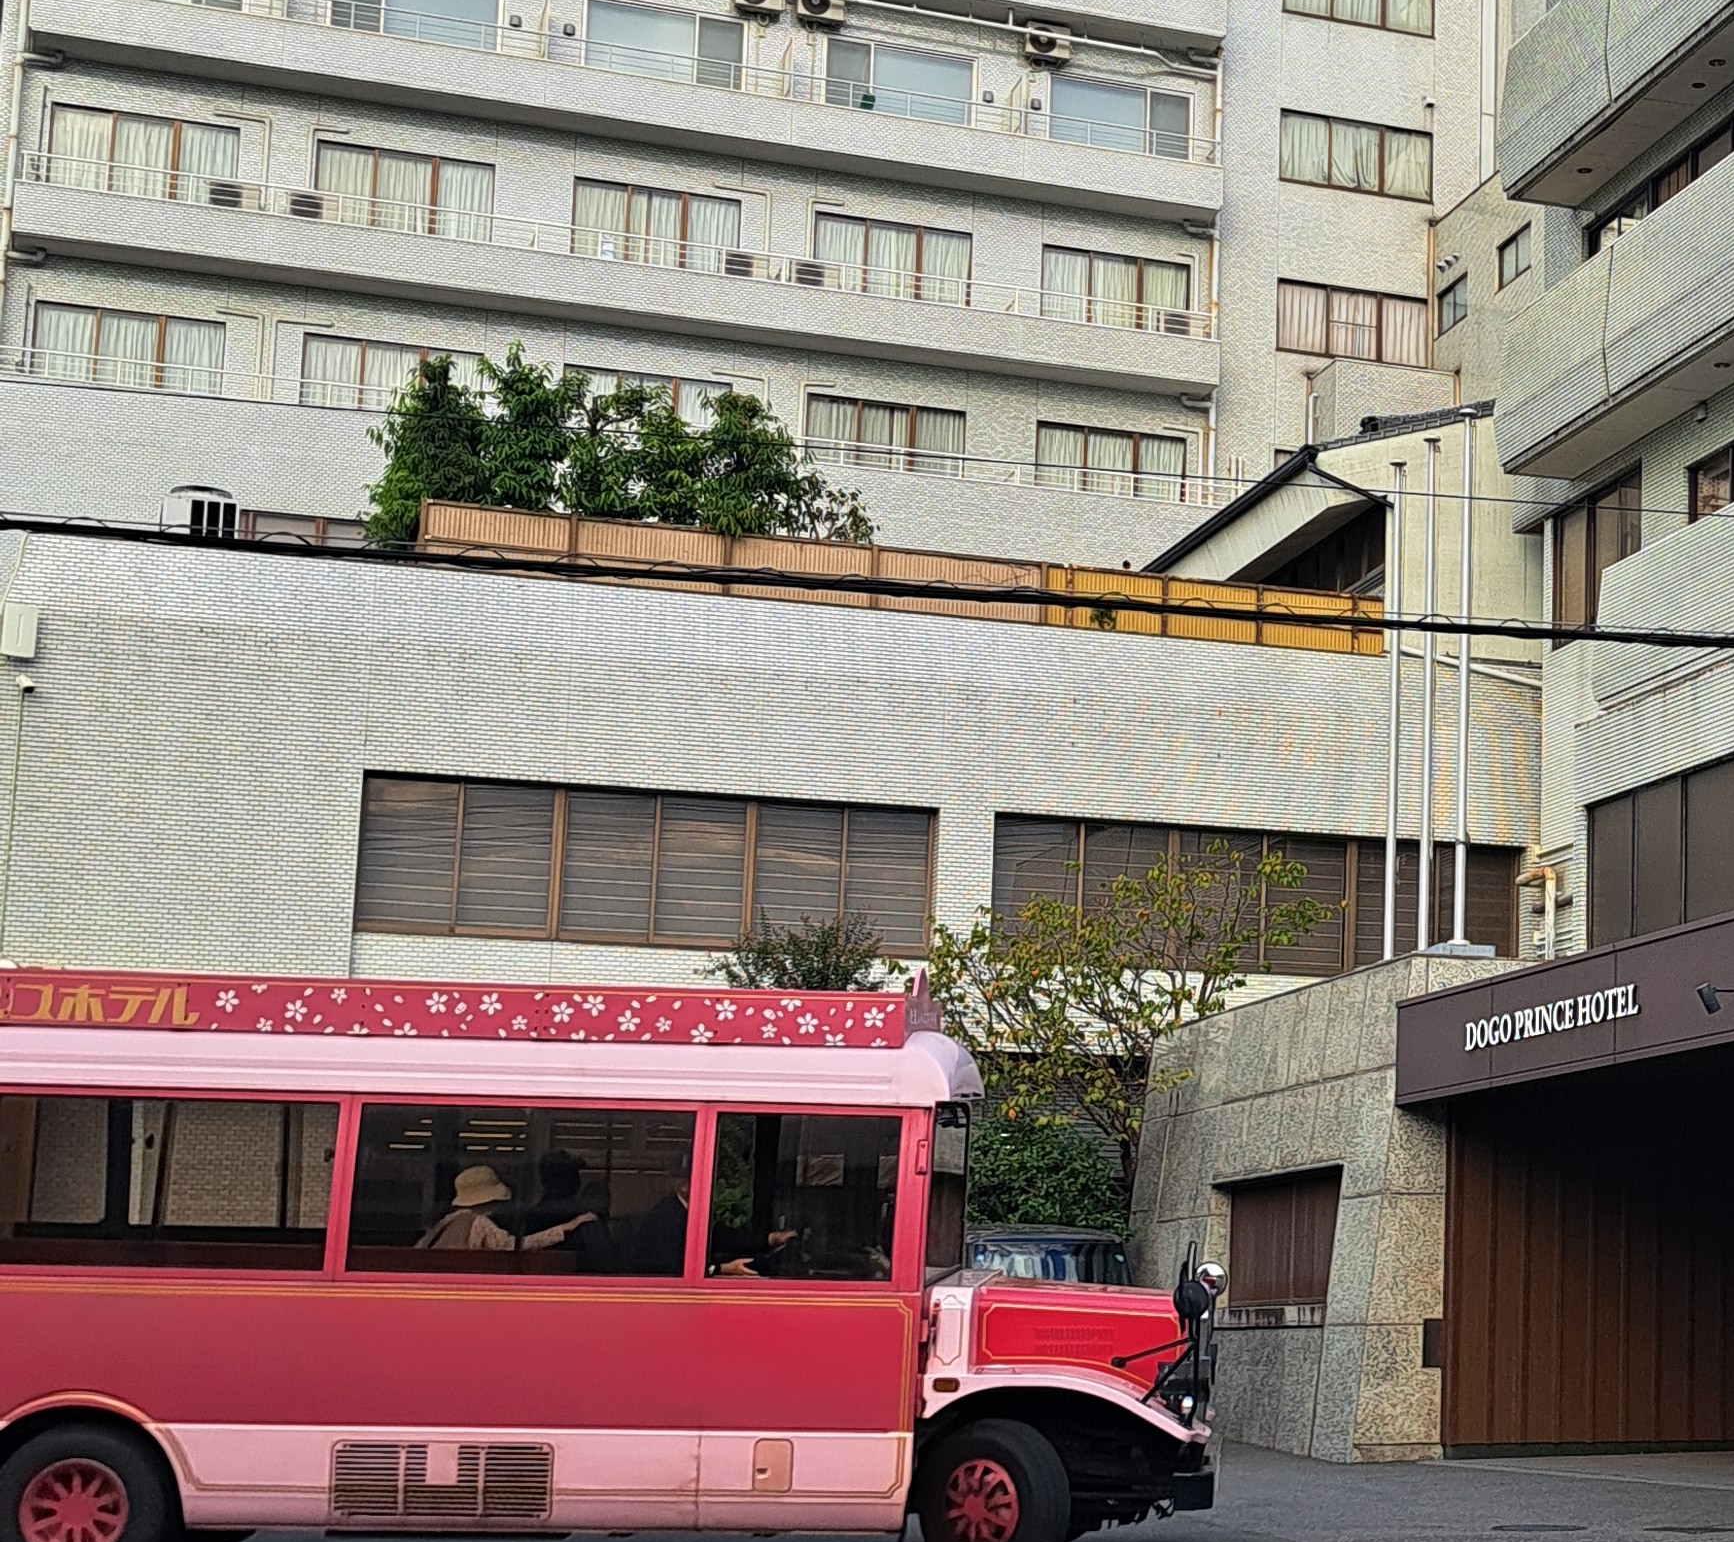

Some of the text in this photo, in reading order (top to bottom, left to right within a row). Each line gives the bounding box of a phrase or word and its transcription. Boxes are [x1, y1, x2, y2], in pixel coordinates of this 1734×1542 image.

[0, 983, 200, 1026] スホテル
[1464, 984, 1639, 1051] DOGO PRINCE HOTEL
